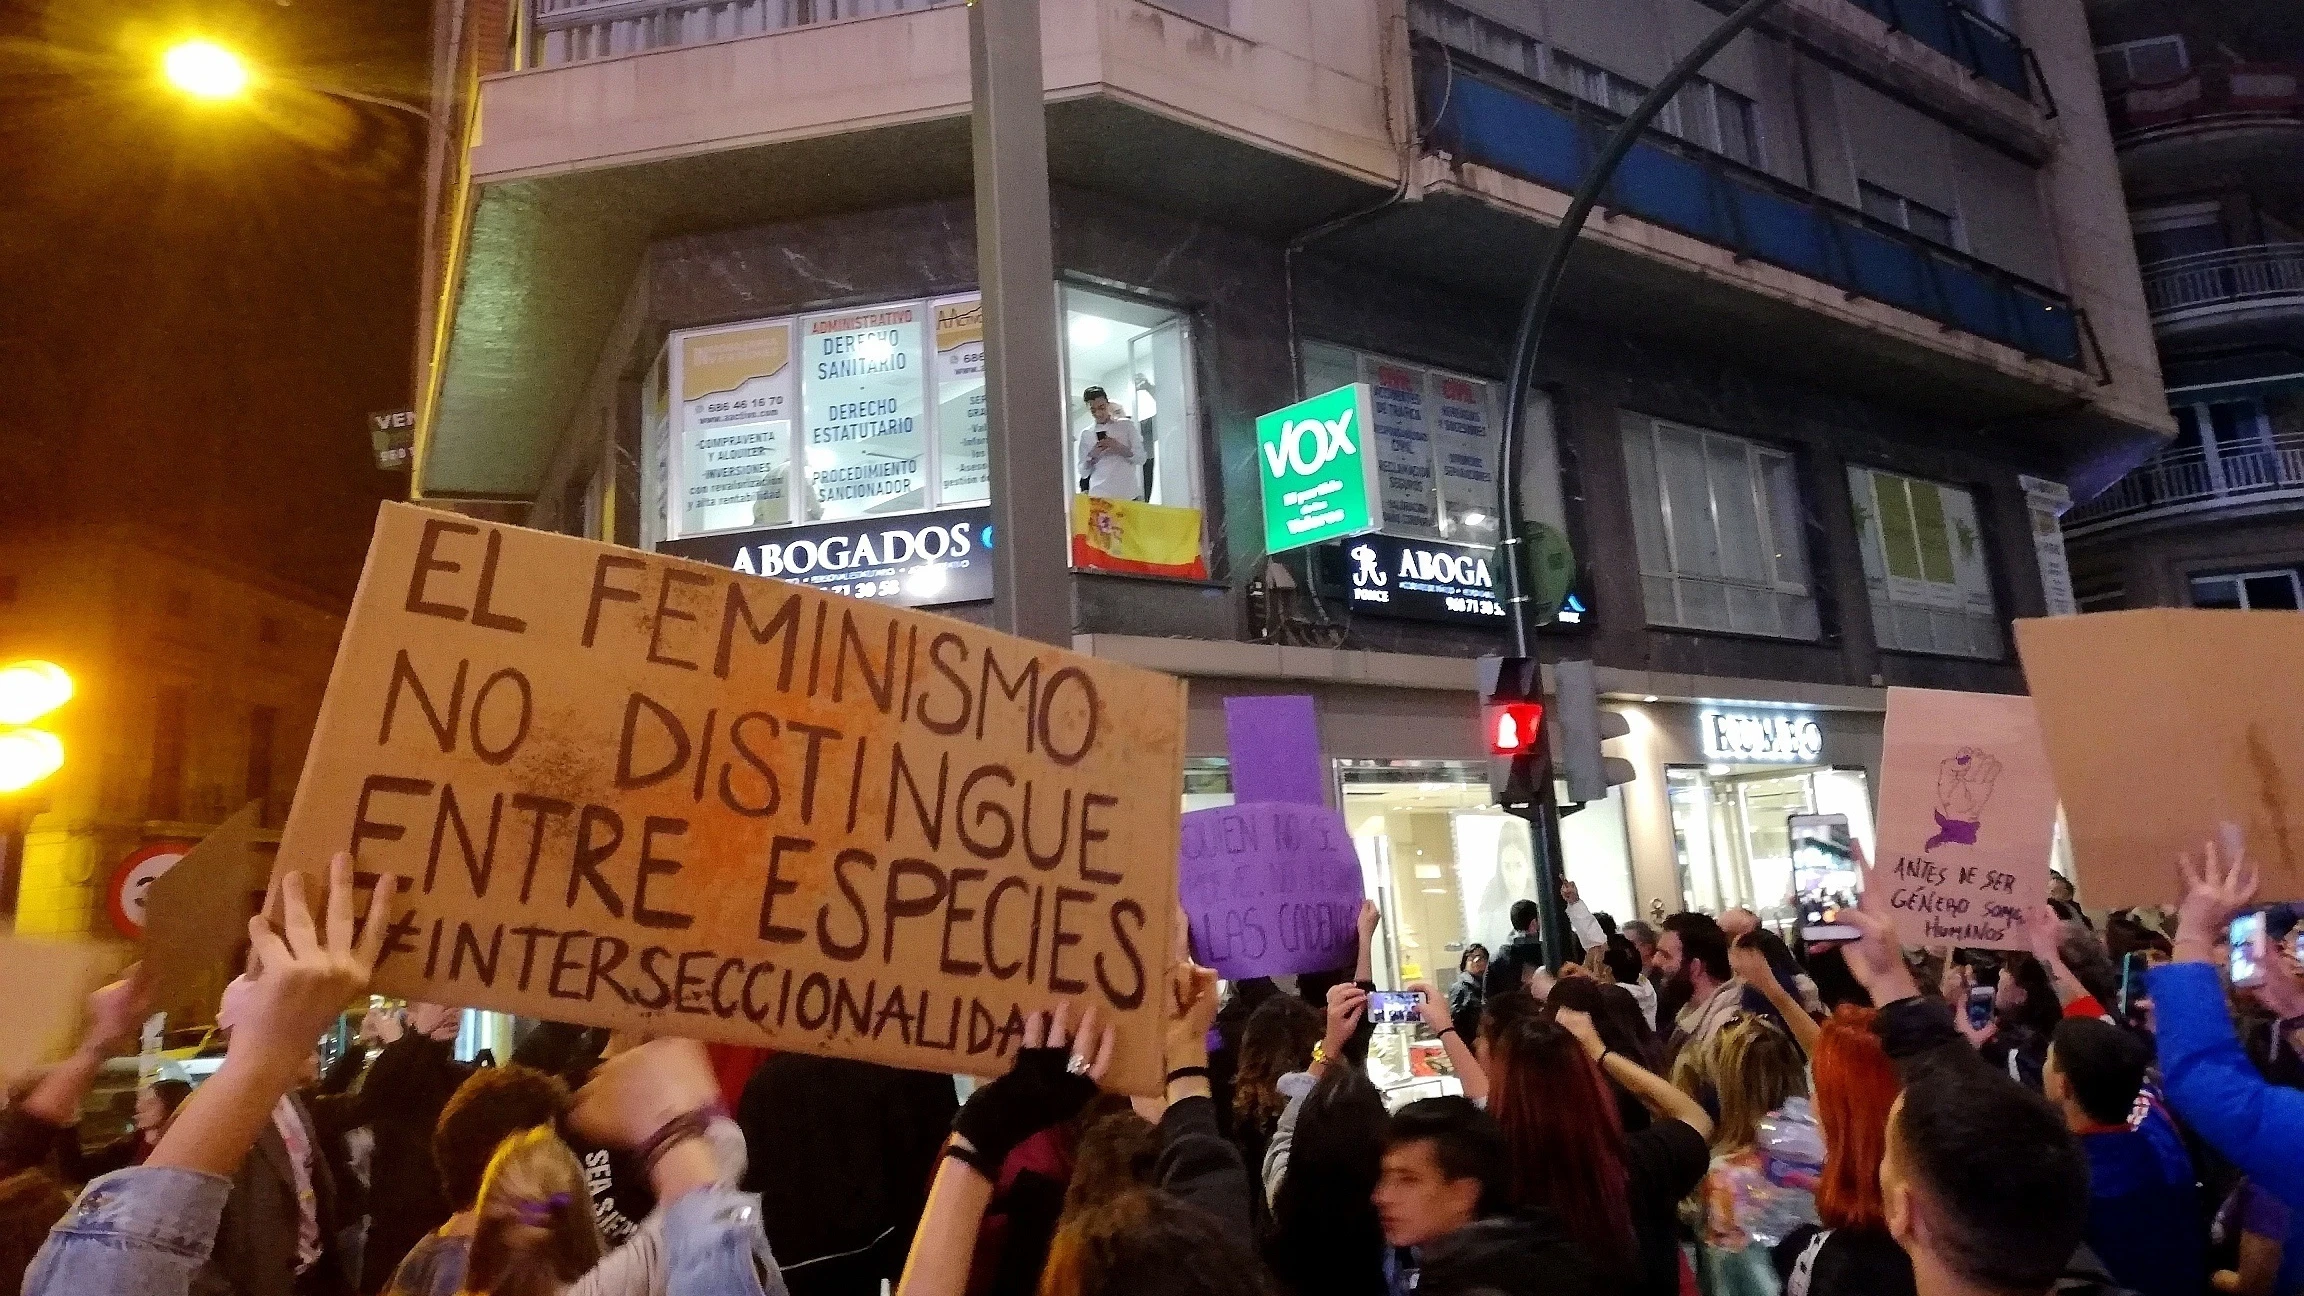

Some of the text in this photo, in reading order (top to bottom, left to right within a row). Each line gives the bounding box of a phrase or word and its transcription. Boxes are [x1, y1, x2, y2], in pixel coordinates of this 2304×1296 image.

[812, 310, 913, 335] ADMINISTRATIVO
[818, 352, 906, 380] SANITARIO
[769, 396, 784, 406] 70
[829, 397, 897, 421] DERECHO
[813, 416, 913, 444] ESTATUTARIO
[1263, 407, 1357, 478] VOX
[813, 459, 917, 485] PROCEDIMIENTO
[819, 479, 911, 503] SANCIONADOR
[731, 522, 971, 578] ABOGADOS
[1398, 548, 1493, 588] ABOGA
[854, 581, 877, 599] 30
[405, 518, 1099, 766] EL FEMINISMO
[378, 646, 1122, 885] NO DISTINGUE
[346, 774, 1148, 1012] ENTRE ESPECIES
[1894, 857, 1948, 886] ANTES
[1980, 869, 2016, 895] SER
[1890, 886, 1971, 918] GÉNERO
[1203, 906, 1268, 963] LAS
[585, 1148, 613, 1197] SEA
